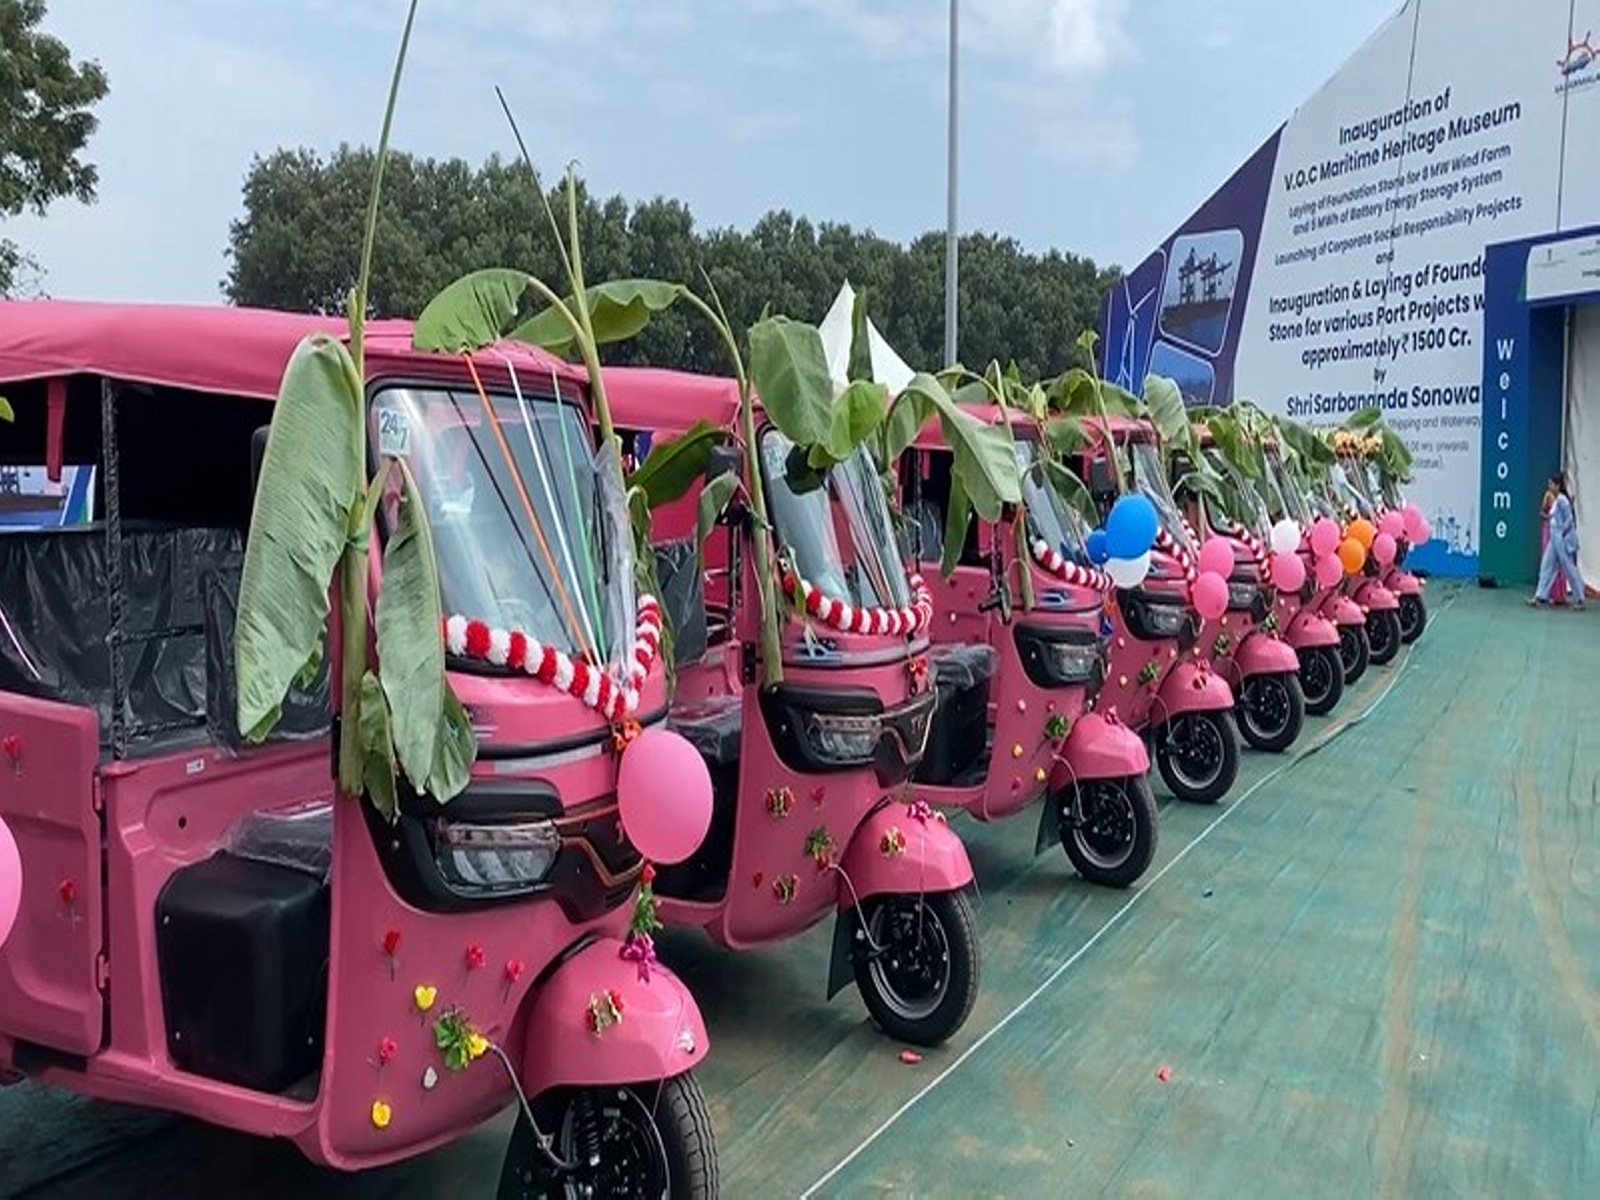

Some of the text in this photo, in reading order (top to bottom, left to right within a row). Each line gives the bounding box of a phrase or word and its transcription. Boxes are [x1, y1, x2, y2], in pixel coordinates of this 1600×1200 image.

[1339, 86, 1450, 146] Inauguration of
[1284, 102, 1521, 191] V.O.C Maritime Heritage Museum
[1327, 184, 1376, 206] Foundation
[1378, 174, 1405, 193] Stone
[1407, 170, 1420, 184] for
[1451, 151, 1479, 172] Wind
[1481, 145, 1511, 163] Farm
[1293, 221, 1309, 235] and
[1350, 203, 1383, 220] Battery
[1385, 193, 1418, 211] Energy
[1420, 181, 1458, 202] Storage
[1461, 170, 1503, 195] System
[1275, 246, 1317, 266] Launching
[1328, 232, 1372, 254] Corporate
[1374, 224, 1402, 243] Social
[1404, 205, 1474, 236] Responsibility
[1475, 196, 1522, 220] Projects
[1375, 250, 1394, 265] and
[1269, 283, 1349, 316] Inauguration
[1352, 280, 1361, 299] &
[1365, 271, 1412, 300] Laying
[1415, 263, 1430, 288] of
[1269, 322, 1302, 341] Stone
[1305, 317, 1322, 336] for
[1324, 309, 1373, 333] various
[1376, 303, 1406, 325] Port
[1408, 294, 1470, 324] Projects
[1302, 336, 1400, 371] approximately
[1412, 328, 1446, 351] 1500
[1449, 327, 1472, 347] Cr.
[1374, 367, 1387, 384] by
[1287, 394, 1313, 417] Shri
[1314, 387, 1408, 414] Sarbananda
[1422, 417, 1439, 428] and
[1493, 338, 1515, 539] Welcome
